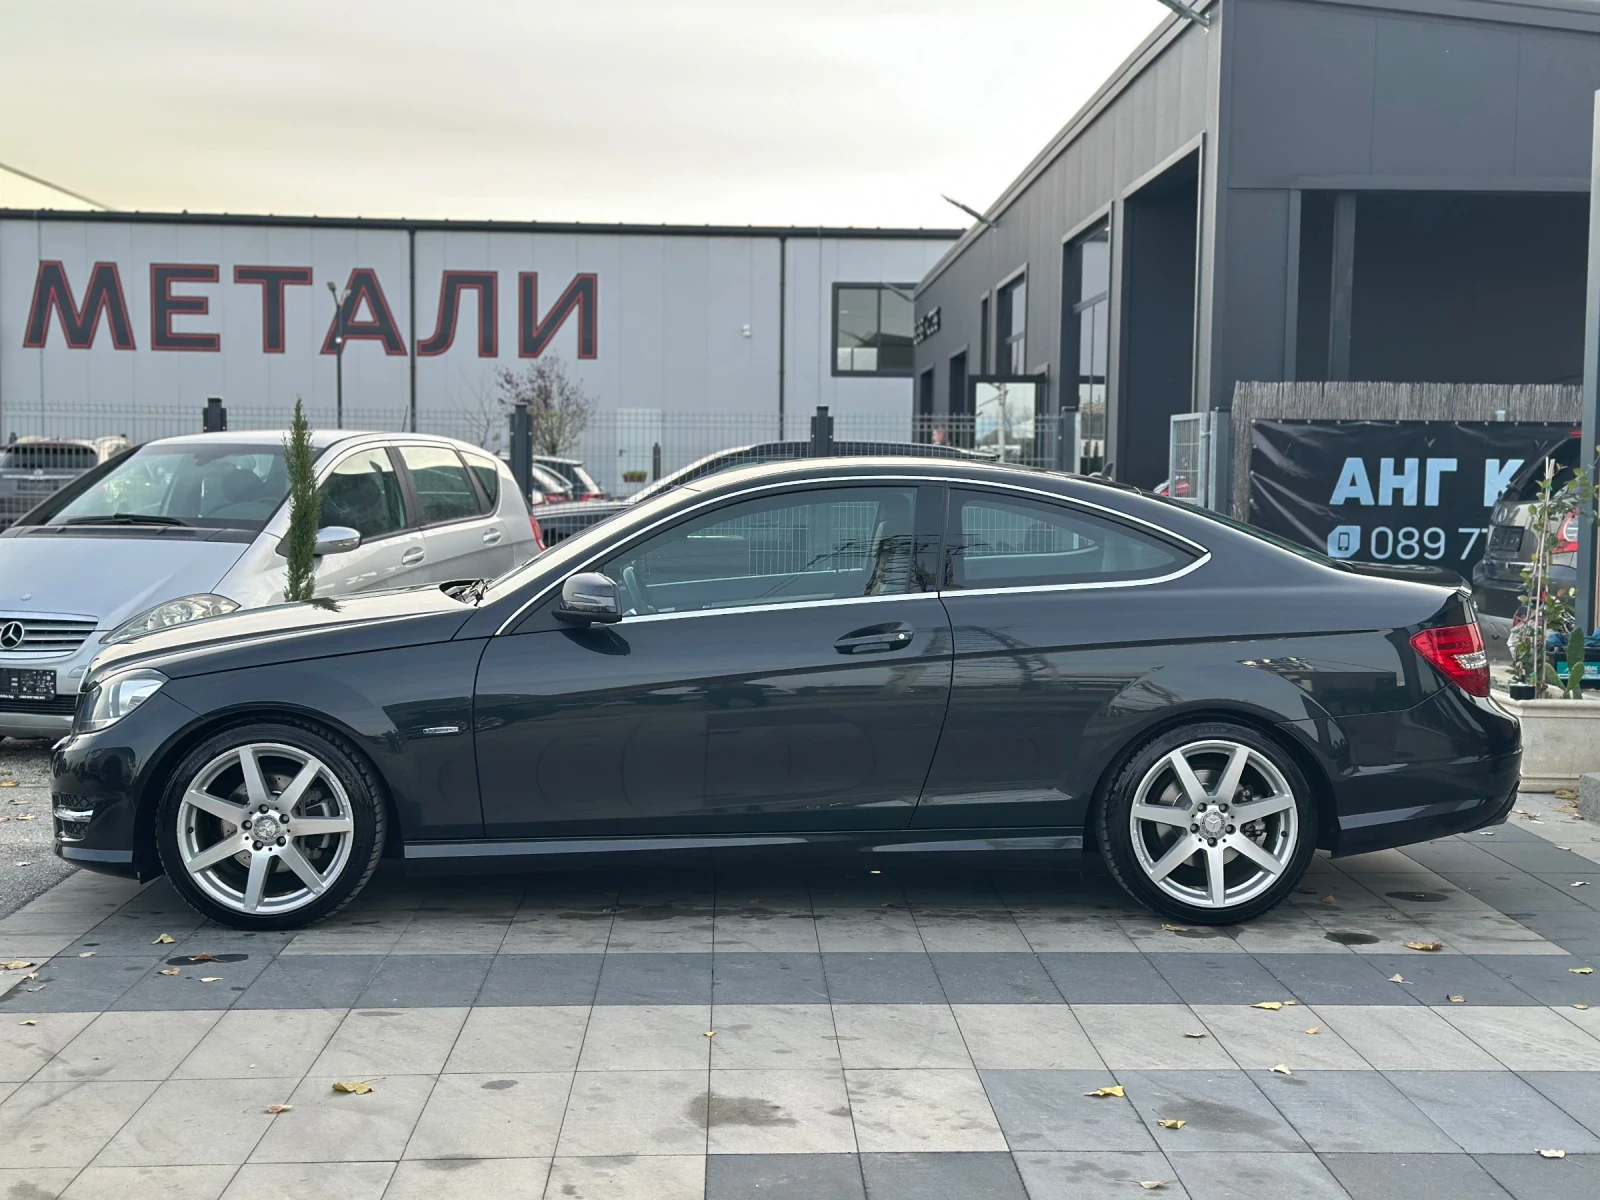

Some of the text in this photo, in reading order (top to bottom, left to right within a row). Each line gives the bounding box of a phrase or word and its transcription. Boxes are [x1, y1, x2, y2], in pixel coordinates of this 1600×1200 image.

[22, 260, 598, 360] МЕТАЛИ
[1329, 457, 1458, 507] АНГ
[1370, 526, 1489, 560] 089 7
